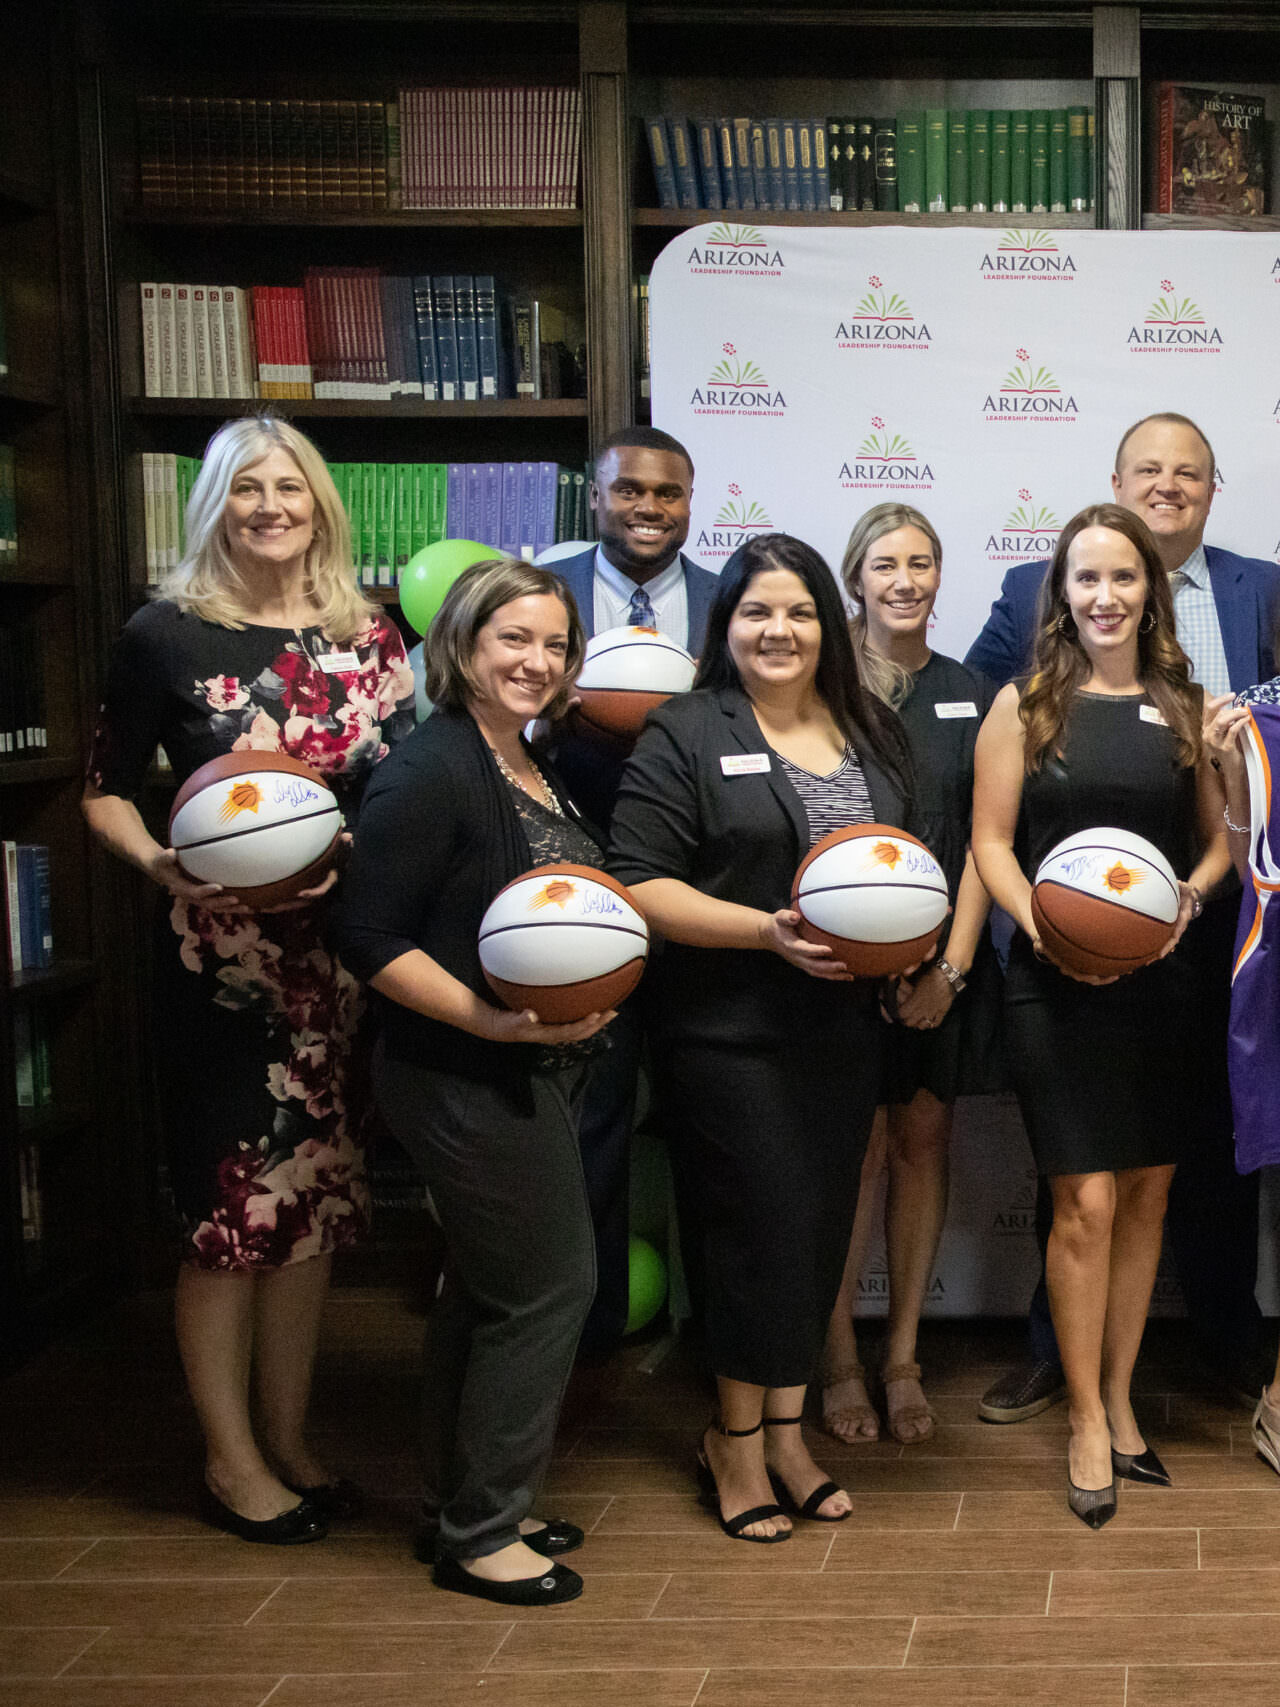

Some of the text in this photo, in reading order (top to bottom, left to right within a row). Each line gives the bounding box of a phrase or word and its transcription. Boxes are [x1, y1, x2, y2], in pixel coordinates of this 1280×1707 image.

[1203, 100, 1264, 117] HISTORY OF
[1222, 114, 1253, 130] ART
[687, 247, 785, 267] ARIZONA
[980, 253, 1077, 272] ARIZONA
[835, 322, 932, 341] ARIZONA
[1127, 327, 1224, 344] ARIZONA
[690, 388, 787, 408] ARIZONA
[982, 394, 1079, 413] ARIZONA
[838, 462, 935, 481] ARIZONA
[696, 530, 759, 547] ARIZ
[985, 534, 1058, 552] ARIZO
[993, 1213, 1039, 1229] ARIZ
[857, 1276, 944, 1293] ARIA
